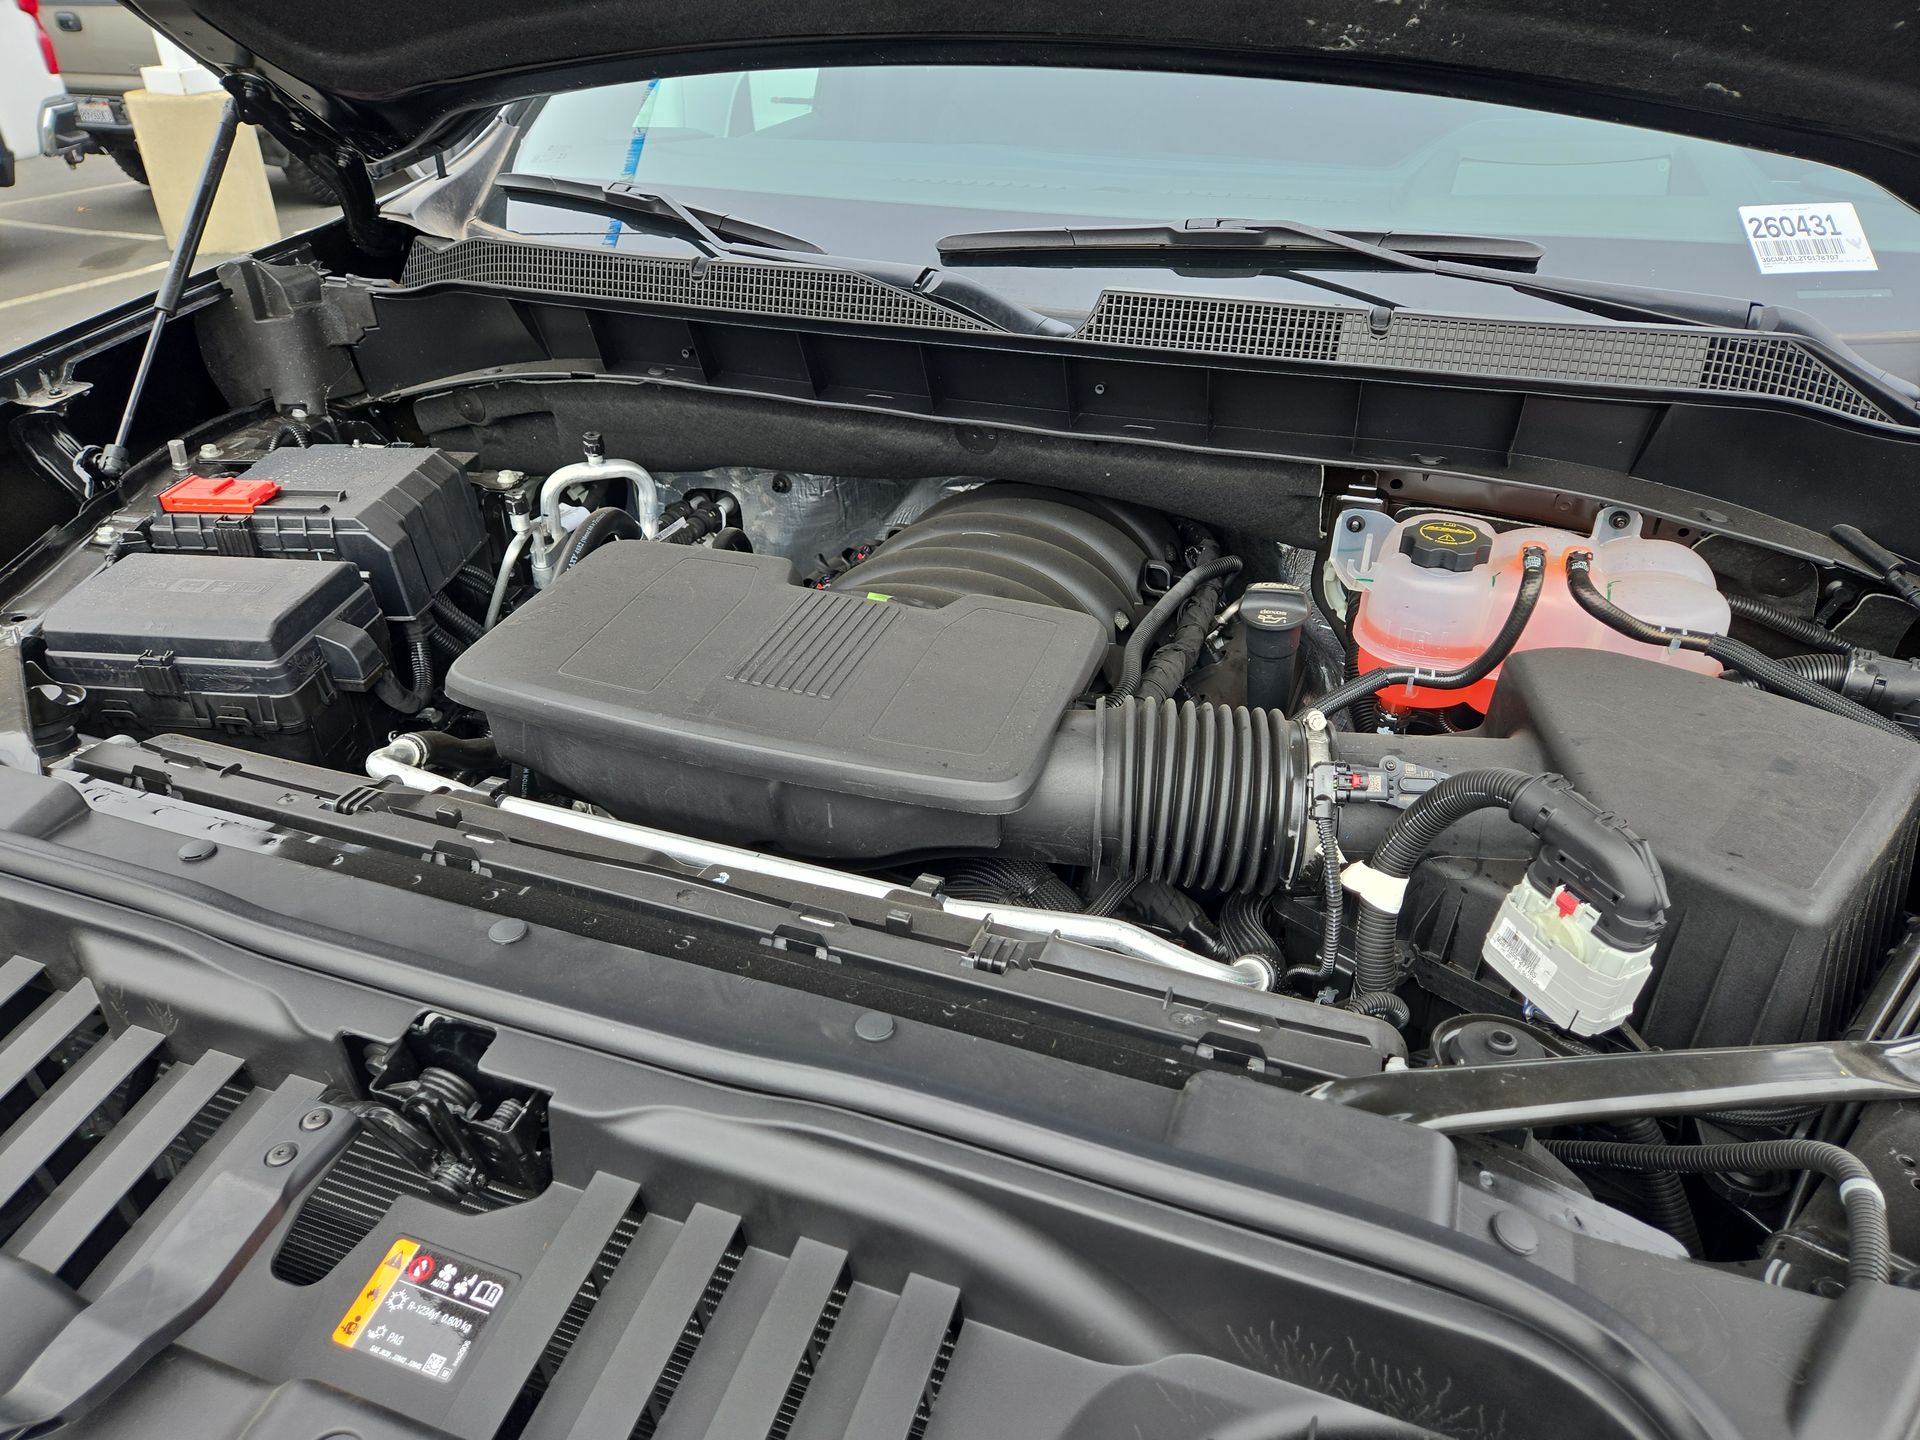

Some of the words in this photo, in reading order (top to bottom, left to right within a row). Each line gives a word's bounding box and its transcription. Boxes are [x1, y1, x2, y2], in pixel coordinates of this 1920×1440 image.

[1748, 214, 1842, 238] 260431
[430, 1278, 450, 1290] AUTO
[406, 1301, 441, 1320] R-1234yf
[440, 1313, 463, 1328] 0.600
[460, 1320, 472, 1334] kg
[386, 1332, 404, 1346] PAG
